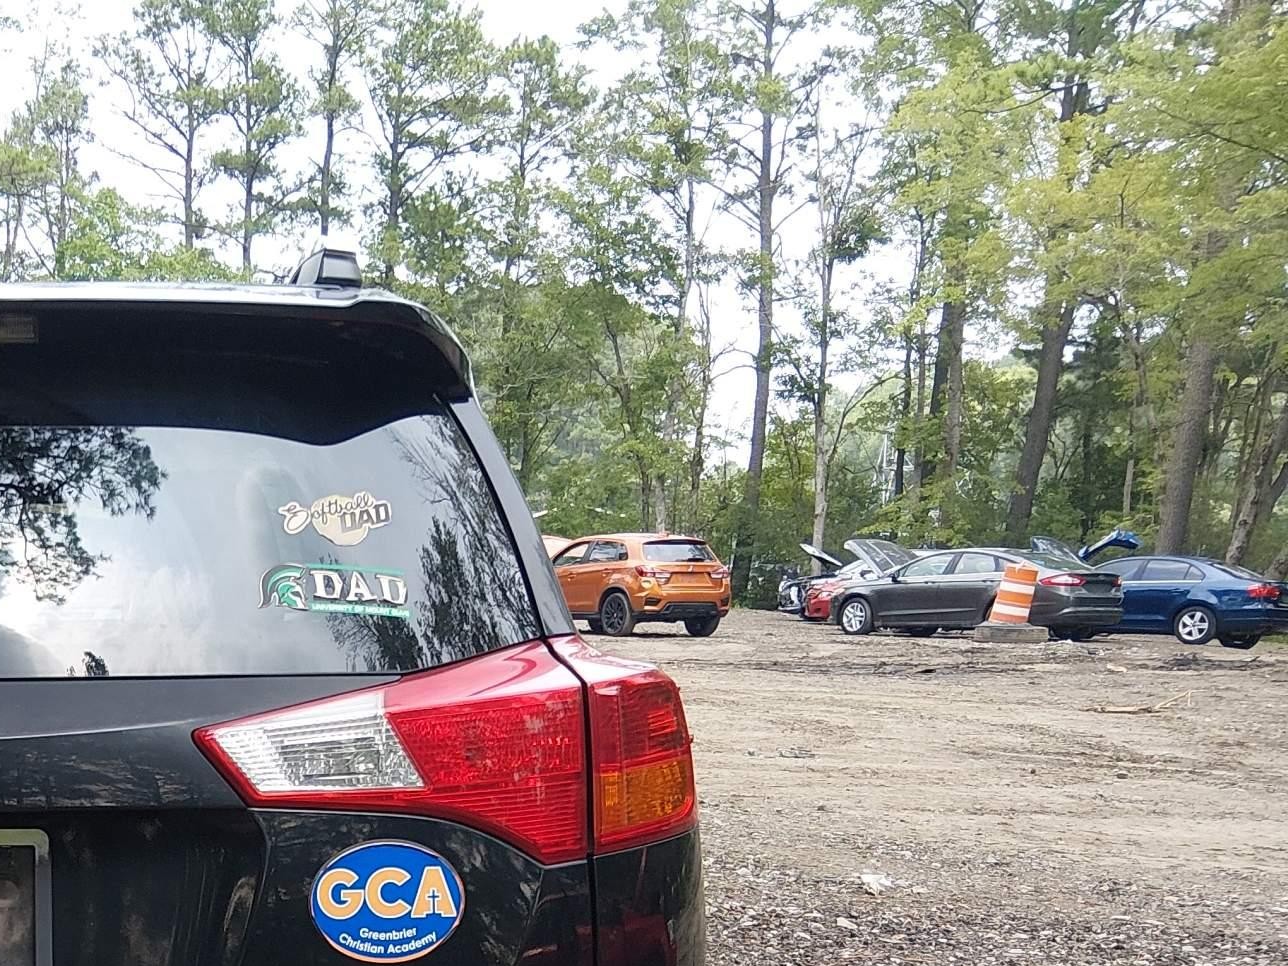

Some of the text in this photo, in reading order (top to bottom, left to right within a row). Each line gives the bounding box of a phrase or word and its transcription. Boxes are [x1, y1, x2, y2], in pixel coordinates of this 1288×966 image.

[282, 493, 373, 532] Softball
[339, 503, 391, 533] DAD
[310, 570, 408, 605] DAD
[317, 866, 457, 920] GCA
[339, 931, 437, 954] Christian Academy
[359, 927, 417, 941] Greenbrier
